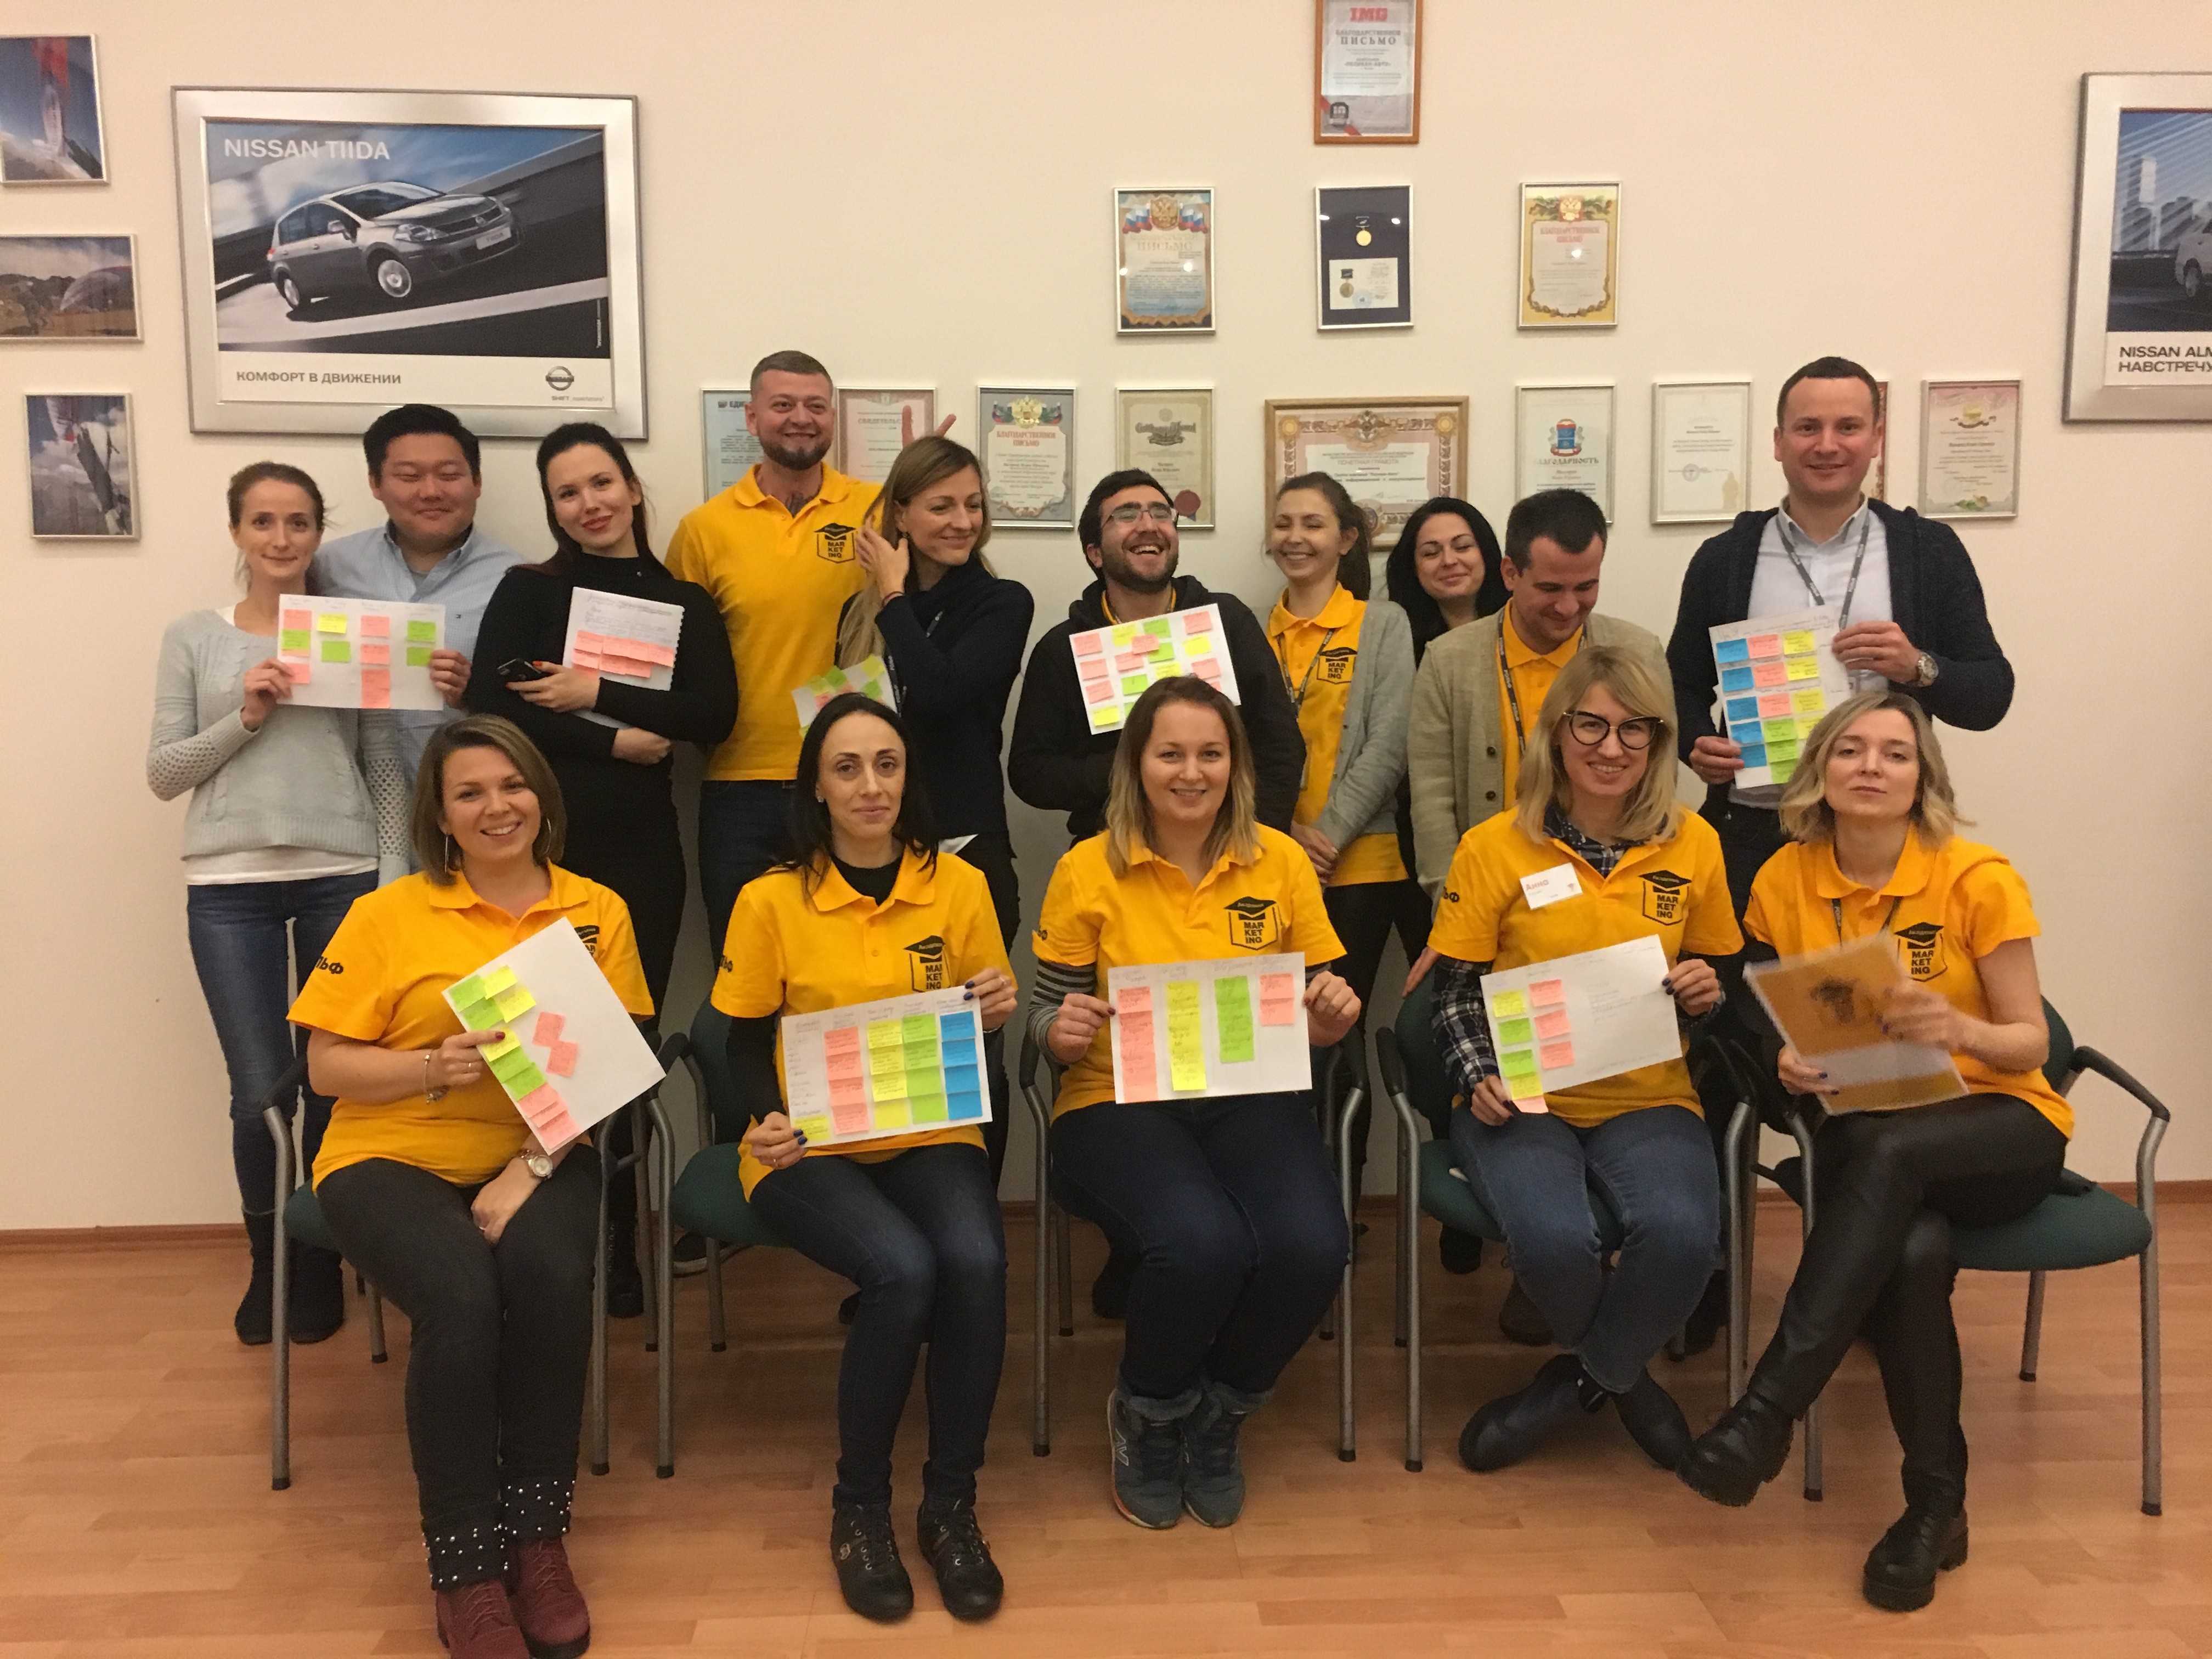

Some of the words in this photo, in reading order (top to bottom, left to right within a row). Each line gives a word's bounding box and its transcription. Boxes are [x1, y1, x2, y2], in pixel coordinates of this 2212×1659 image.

[1341, 36, 1396, 45] ПИСЬМО
[224, 138, 318, 158] NISSAN
[325, 140, 391, 160] TIIDA
[2119, 346, 2180, 358] NISSAN
[236, 371, 306, 382] КОМФОРТ
[309, 373, 318, 382] В
[321, 373, 402, 385] ДВИЖЕНИИ
[1657, 895, 1678, 904] MAR
[1657, 902, 1676, 911] KET
[1911, 958, 1932, 966] KET
